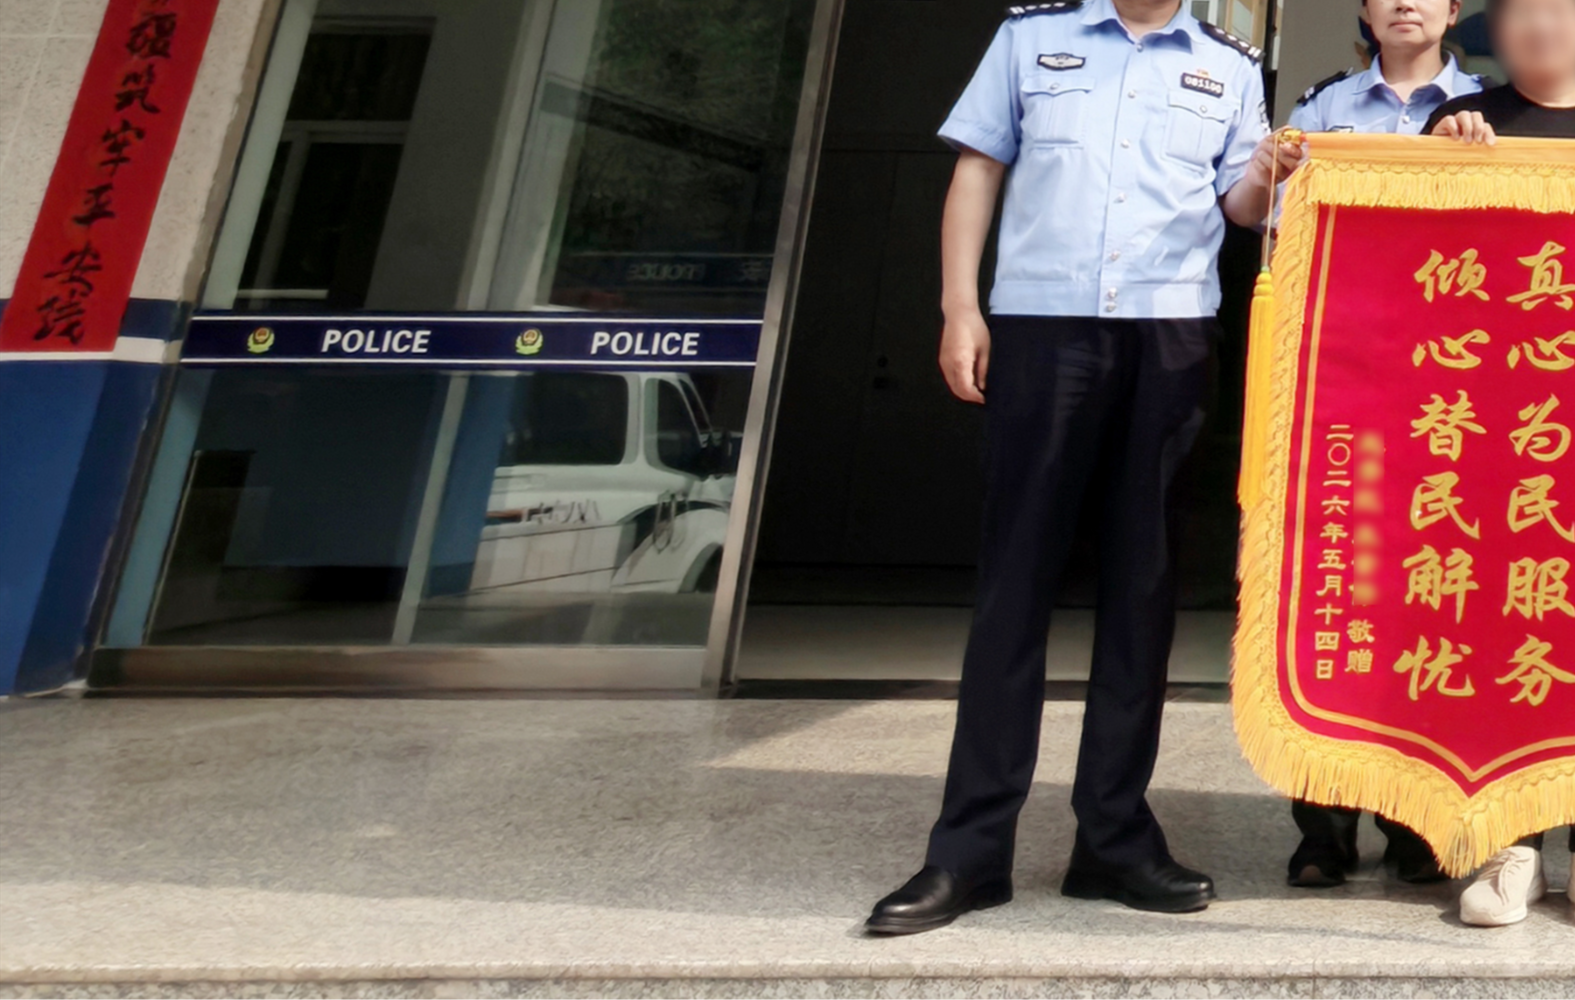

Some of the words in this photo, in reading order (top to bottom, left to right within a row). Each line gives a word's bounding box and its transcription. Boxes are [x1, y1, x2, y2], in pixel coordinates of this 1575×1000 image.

[321, 329, 432, 355] POLICE
[590, 330, 700, 356] POLICE
[1392, 247, 1491, 702] 倾心替民解忧
[1344, 618, 1376, 674] 敬赠
